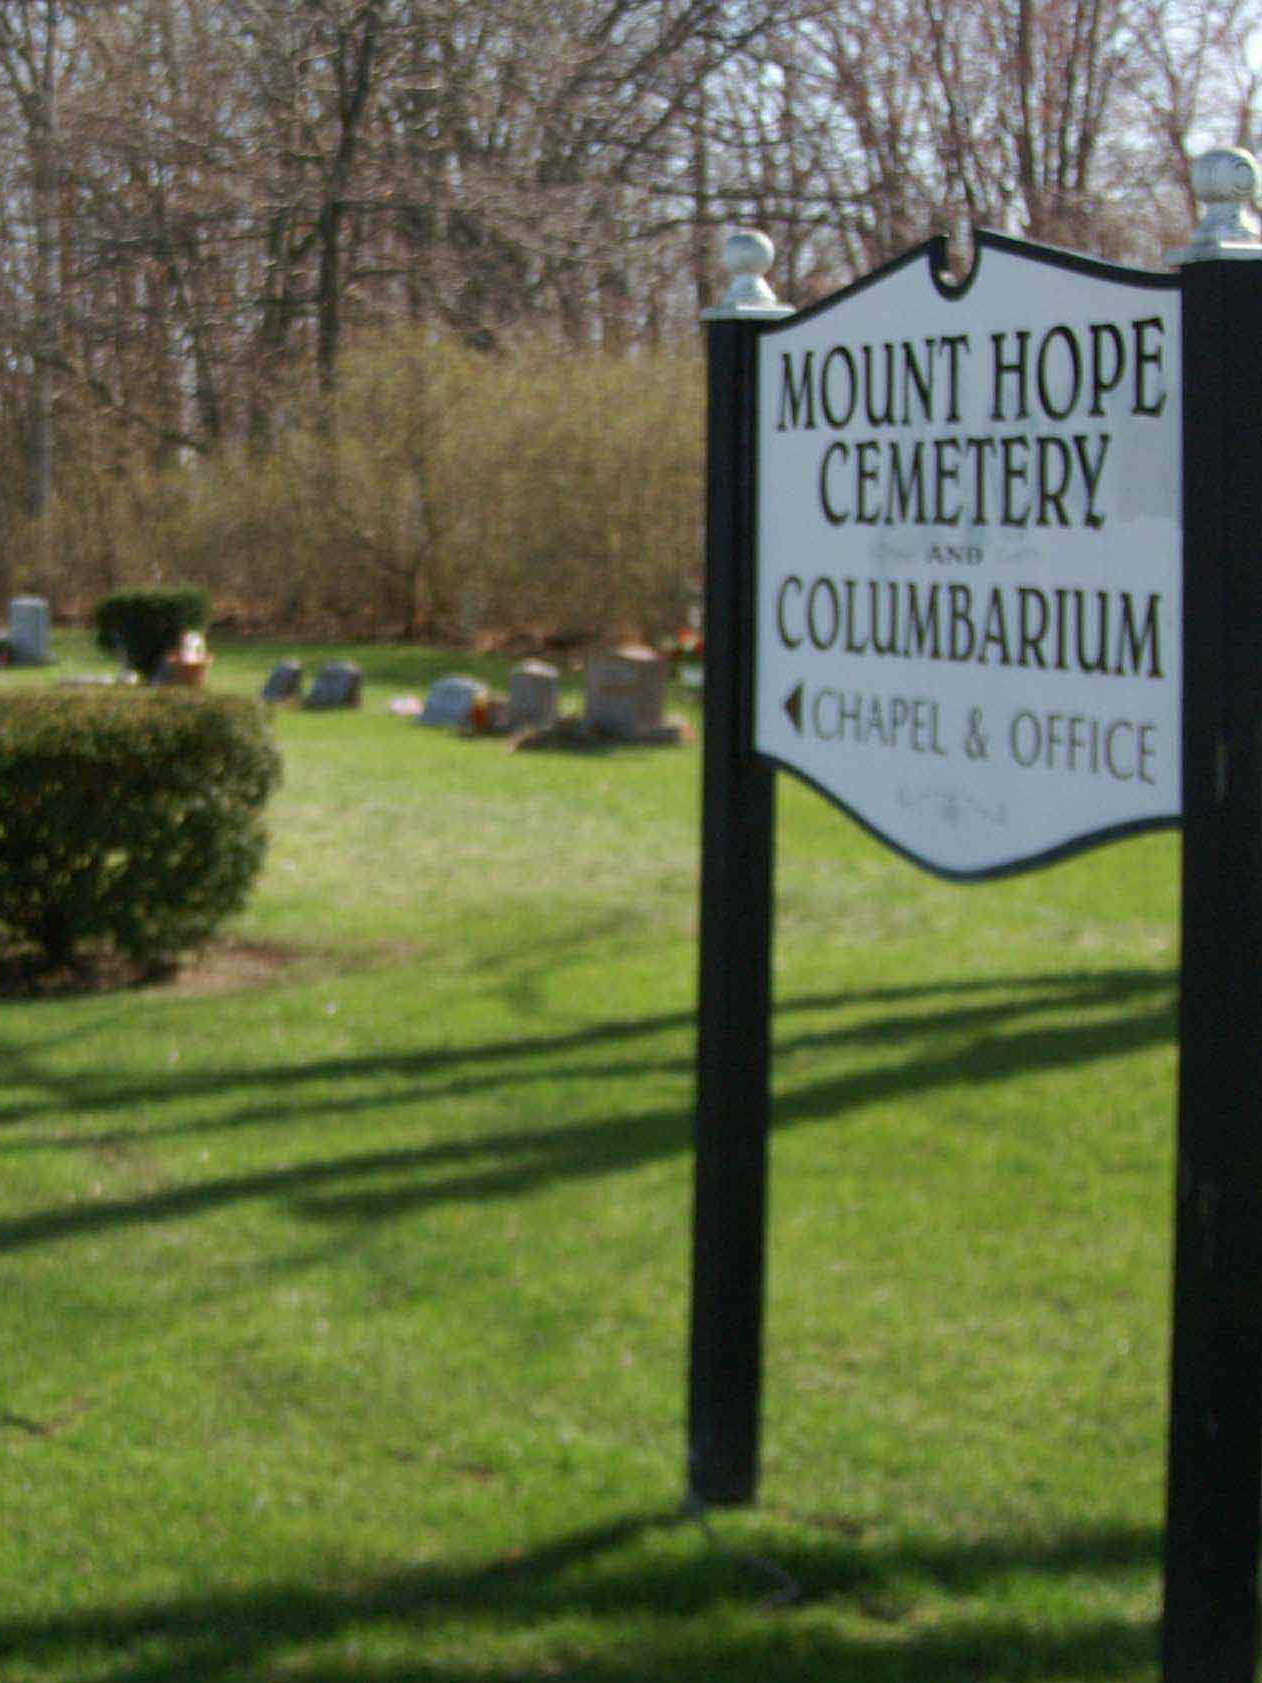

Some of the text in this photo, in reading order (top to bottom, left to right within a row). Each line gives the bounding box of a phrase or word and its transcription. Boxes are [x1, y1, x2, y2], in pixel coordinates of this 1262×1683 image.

[779, 316, 1168, 431] MOUNT HOPE
[819, 434, 1111, 530] CEMETERY
[926, 546, 984, 566] AND
[775, 575, 1165, 679] COLUMBARIUM
[811, 688, 1157, 785] CHAPEL & OFFICE
